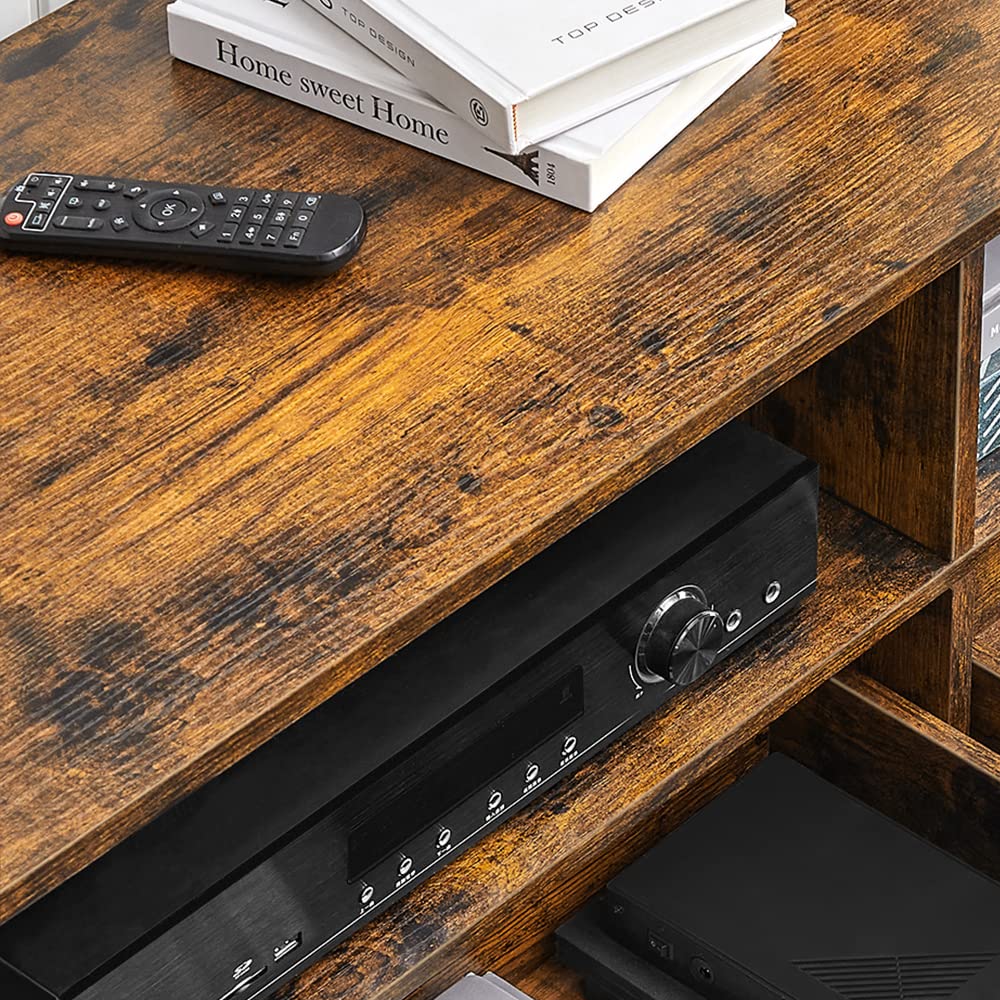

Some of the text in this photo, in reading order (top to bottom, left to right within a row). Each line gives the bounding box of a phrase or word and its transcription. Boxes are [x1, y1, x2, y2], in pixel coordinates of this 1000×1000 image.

[551, 0, 663, 45] TOP DES
[341, 6, 416, 68] TOP DESIGN
[215, 38, 449, 145] Home sweet Home
[239, 195, 249, 203] 3
[283, 199, 292, 207] 9
[161, 203, 177, 217] OK
[253, 213, 263, 221] 5
